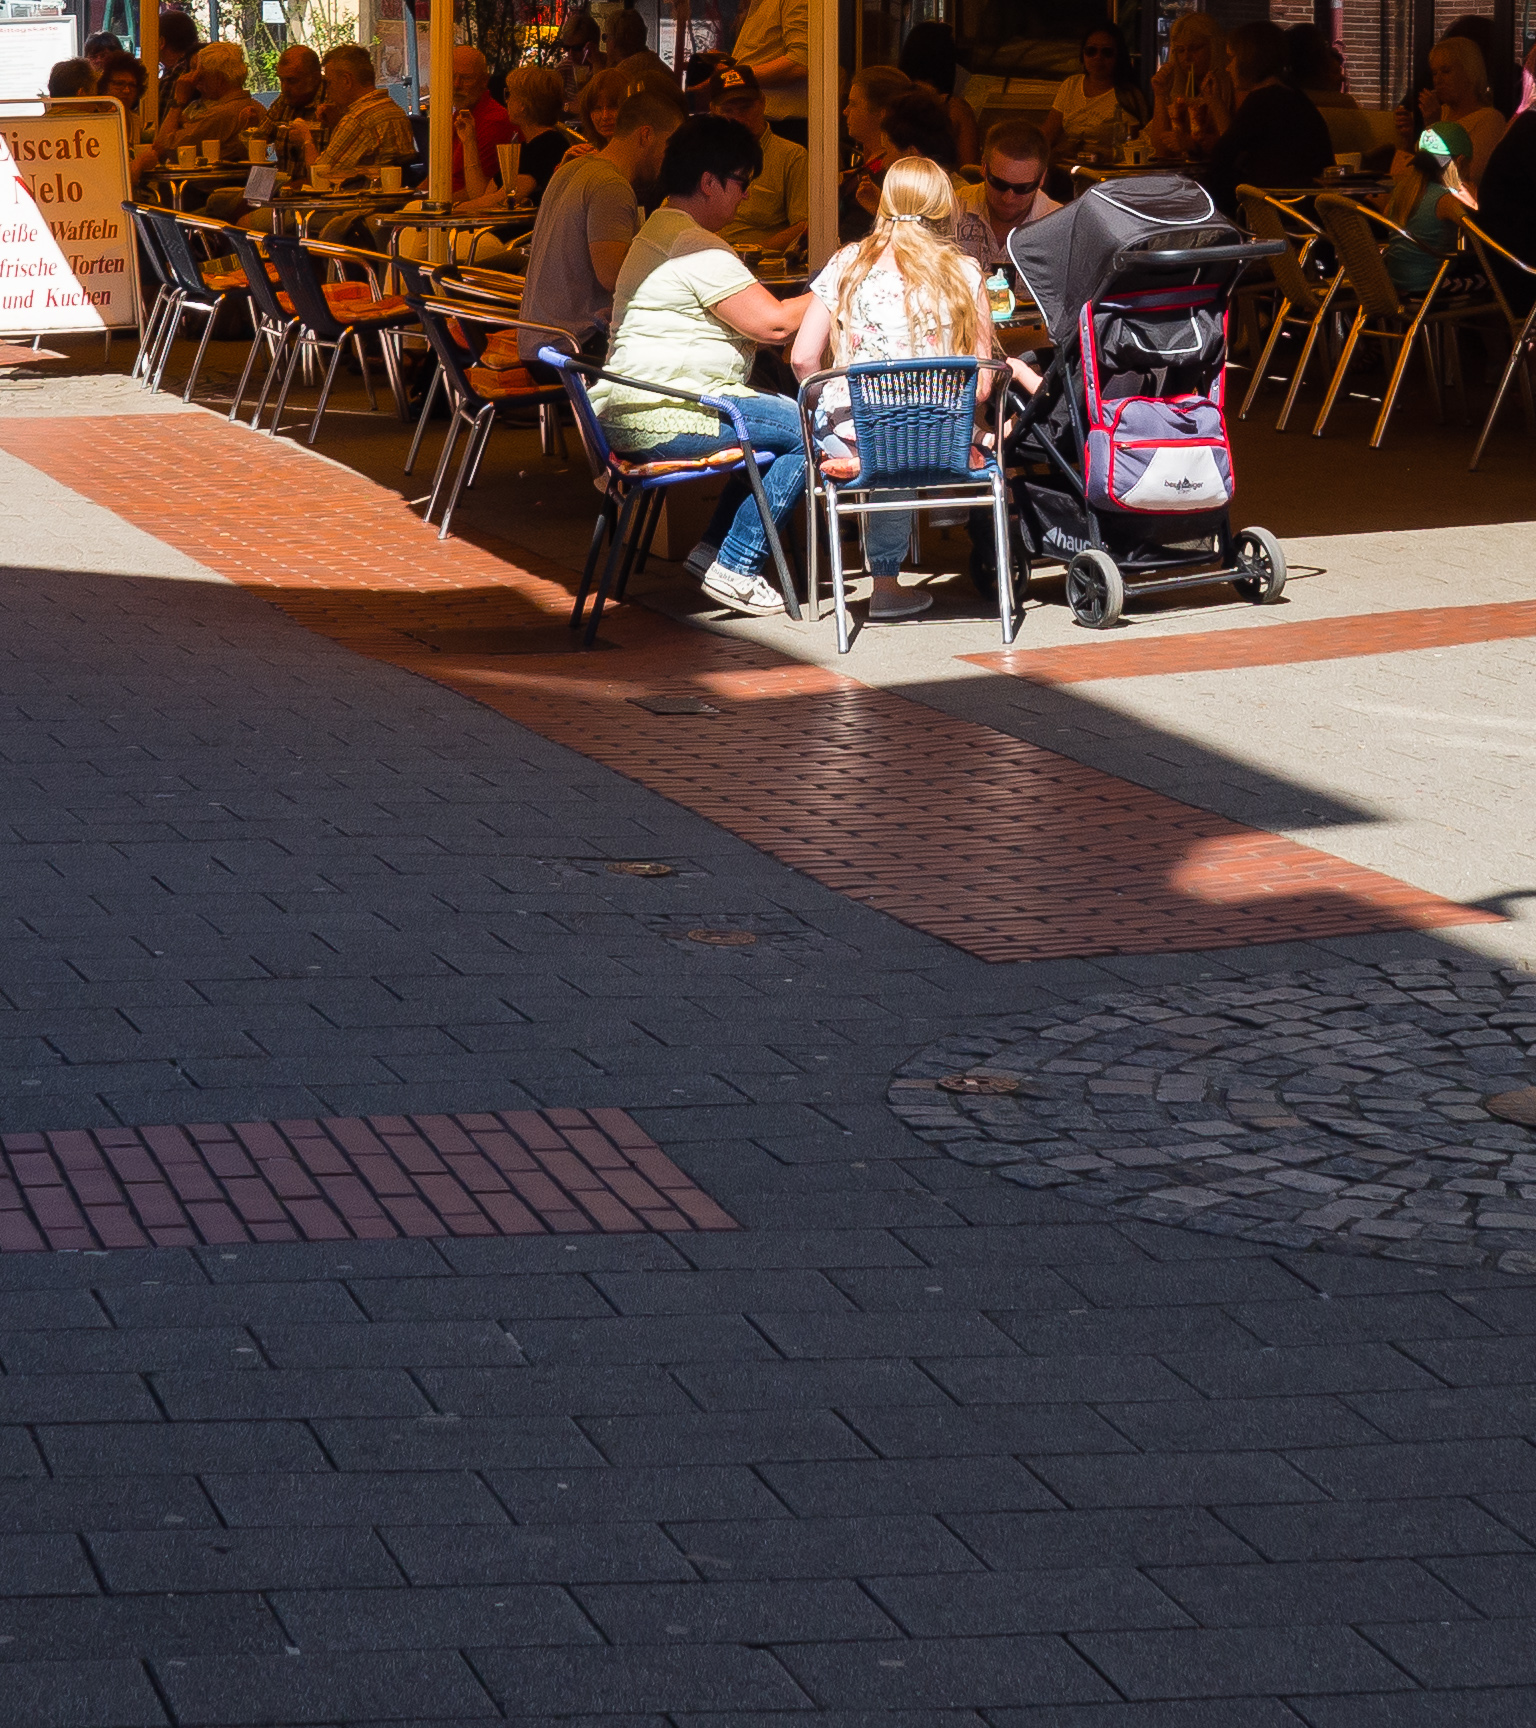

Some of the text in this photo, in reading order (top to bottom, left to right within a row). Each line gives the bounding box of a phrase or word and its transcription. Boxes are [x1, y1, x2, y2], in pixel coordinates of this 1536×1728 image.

[13, 173, 84, 204] Nelo
[50, 218, 119, 241] Waffeln
[68, 255, 126, 275] Torten
[2, 286, 111, 310] und Kuchen
